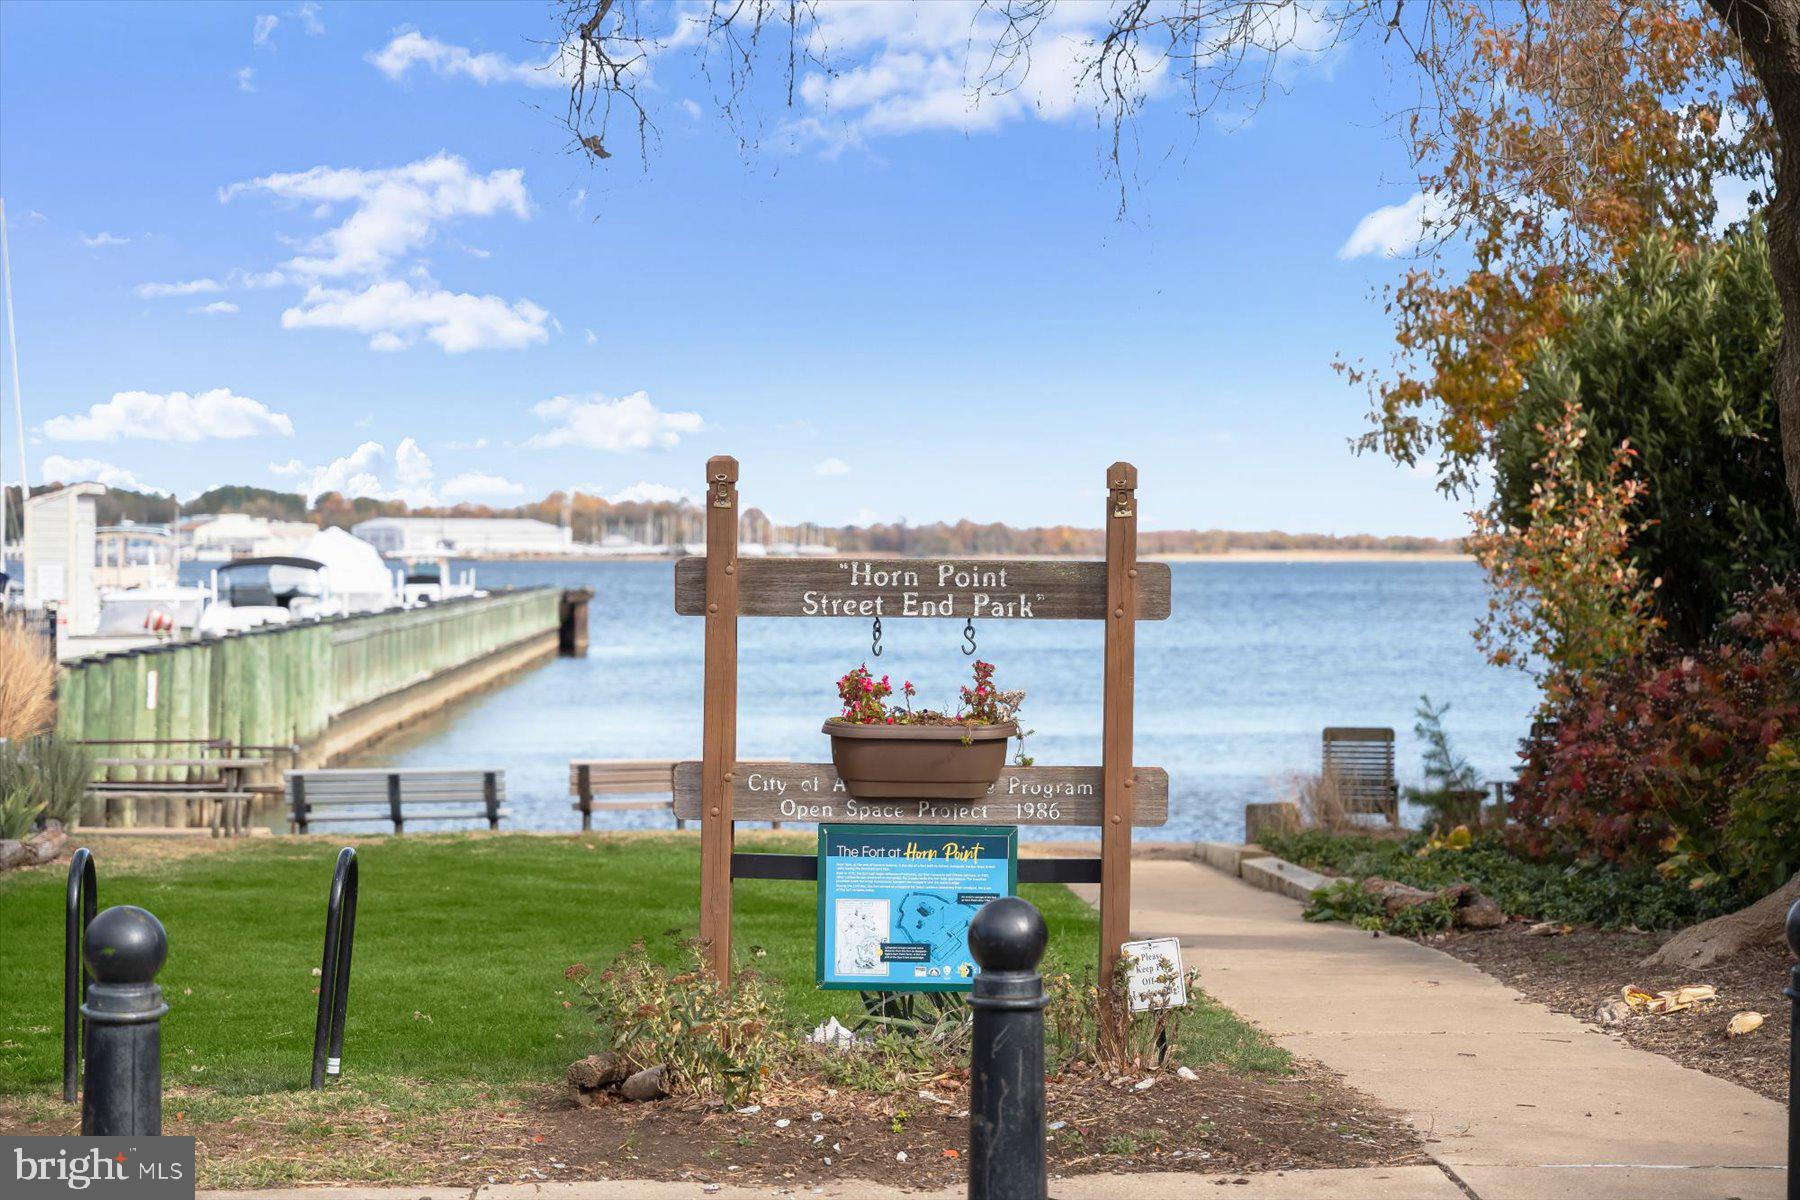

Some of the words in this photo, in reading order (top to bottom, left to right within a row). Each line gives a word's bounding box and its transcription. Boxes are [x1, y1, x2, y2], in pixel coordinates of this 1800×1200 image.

[839, 561, 919, 587] "Horn
[938, 564, 1008, 588] Point
[802, 590, 884, 616] Street
[902, 591, 954, 617] End
[973, 592, 1045, 618] Park"
[748, 773, 787, 795] City
[801, 777, 820, 792] of
[1008, 776, 1093, 799] Program
[780, 799, 833, 820] Open
[846, 799, 904, 820] Space
[918, 800, 988, 821] Project
[1016, 802, 1060, 820] 1986
[836, 844, 859, 858] The
[862, 845, 886, 858] Fort
[887, 846, 902, 859] at
[903, 841, 937, 862] Horn
[942, 842, 985, 865] Point
[1136, 964, 1154, 974] Keep
